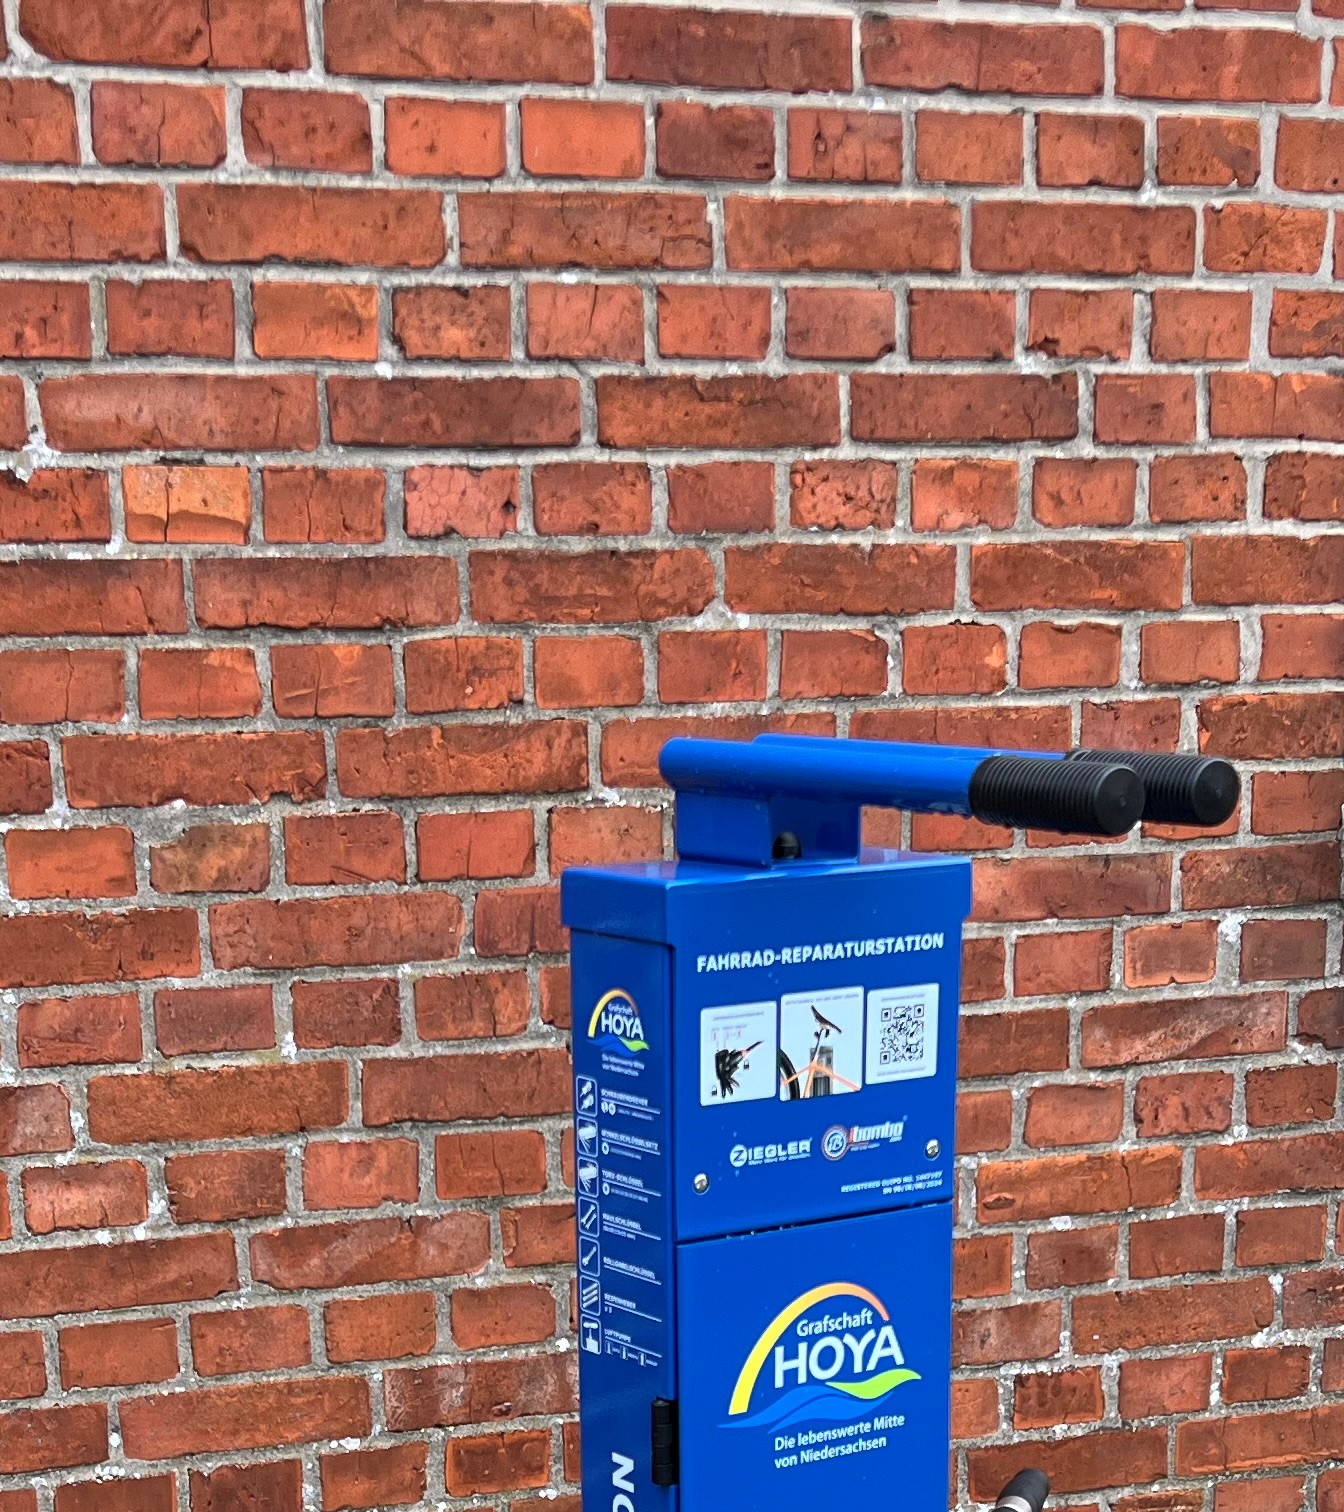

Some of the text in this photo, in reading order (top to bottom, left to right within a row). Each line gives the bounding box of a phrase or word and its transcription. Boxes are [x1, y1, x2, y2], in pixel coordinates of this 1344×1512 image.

[697, 933, 944, 972] FAHRRAD-REPARATURSTATION
[601, 1011, 644, 1040] HOYA
[730, 1139, 811, 1167] ZIEGLER
[796, 1307, 874, 1337] Grafschaft
[774, 1324, 905, 1389] HOYA
[774, 1415, 905, 1451] Die lebenswerte Mitte
[774, 1437, 887, 1469] von Niedersachsen
